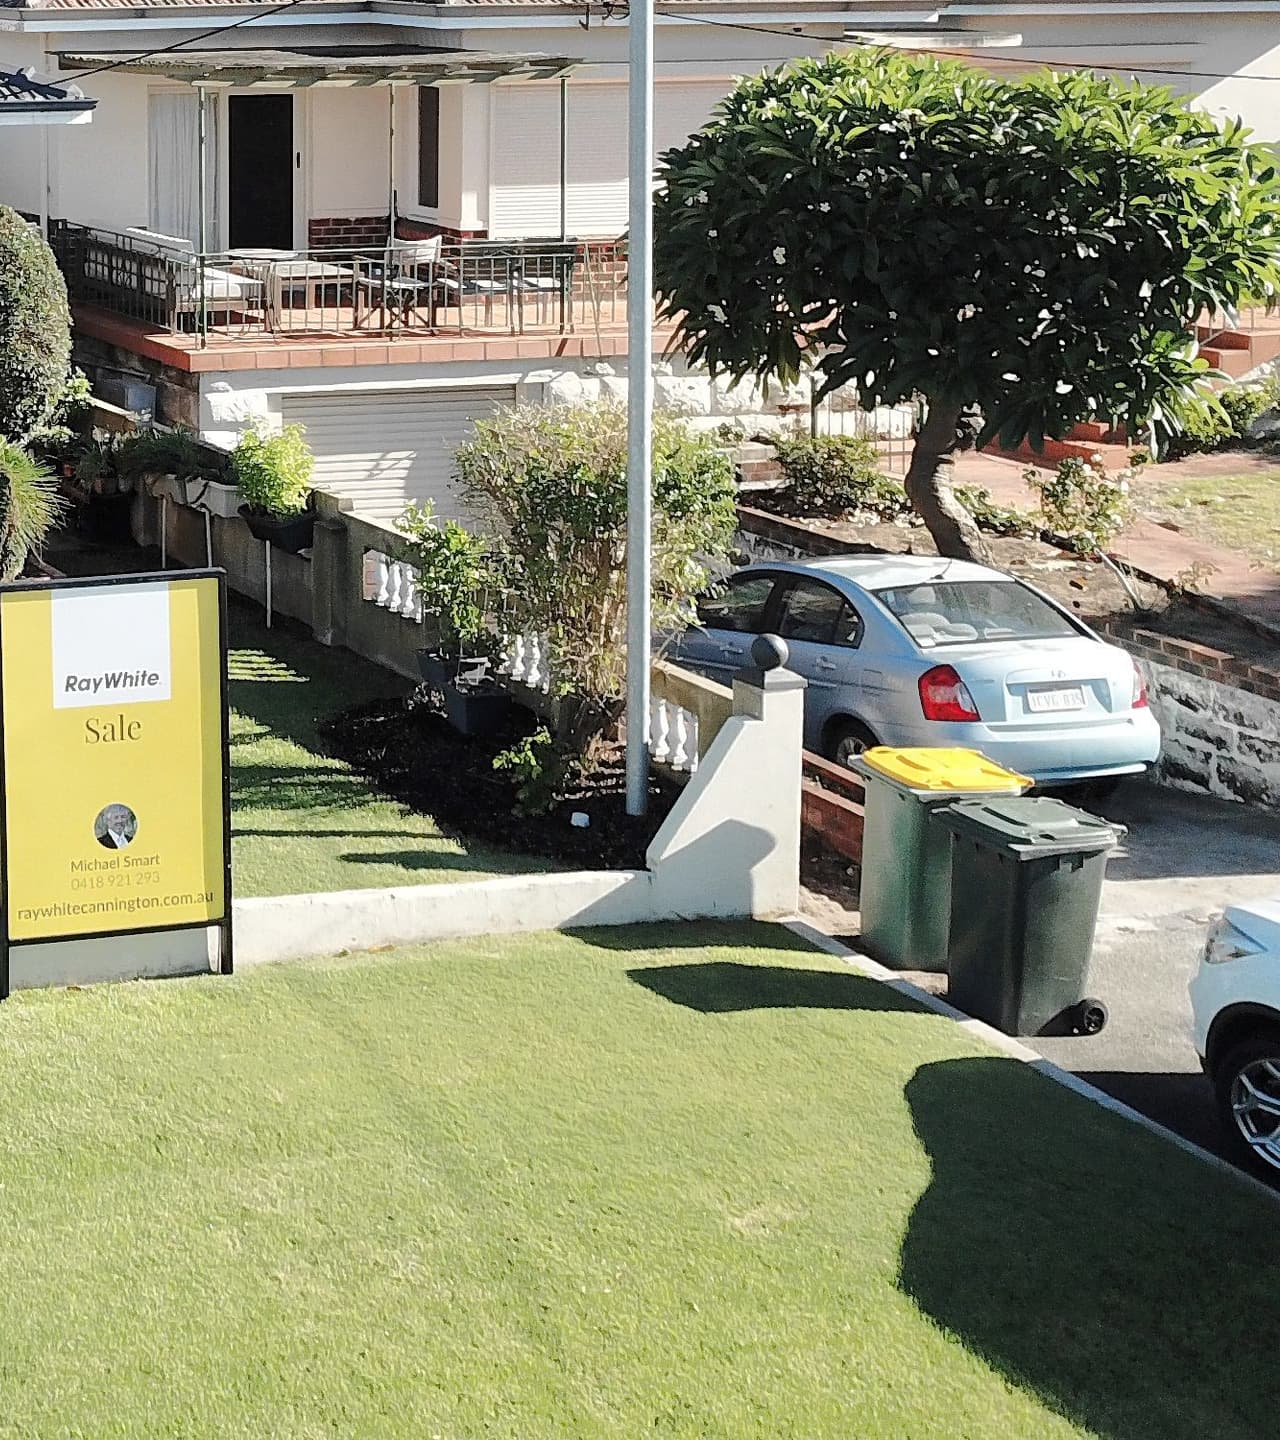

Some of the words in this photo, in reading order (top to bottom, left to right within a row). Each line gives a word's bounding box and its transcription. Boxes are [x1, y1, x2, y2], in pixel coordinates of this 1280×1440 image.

[85, 714, 142, 745] Sale
[71, 857, 120, 873] Michael
[124, 854, 160, 868] Smart
[71, 875, 105, 891] 0418
[107, 873, 132, 888] 921
[136, 871, 160, 886] 293
[18, 892, 215, 921] raywhitecannington.com.au
